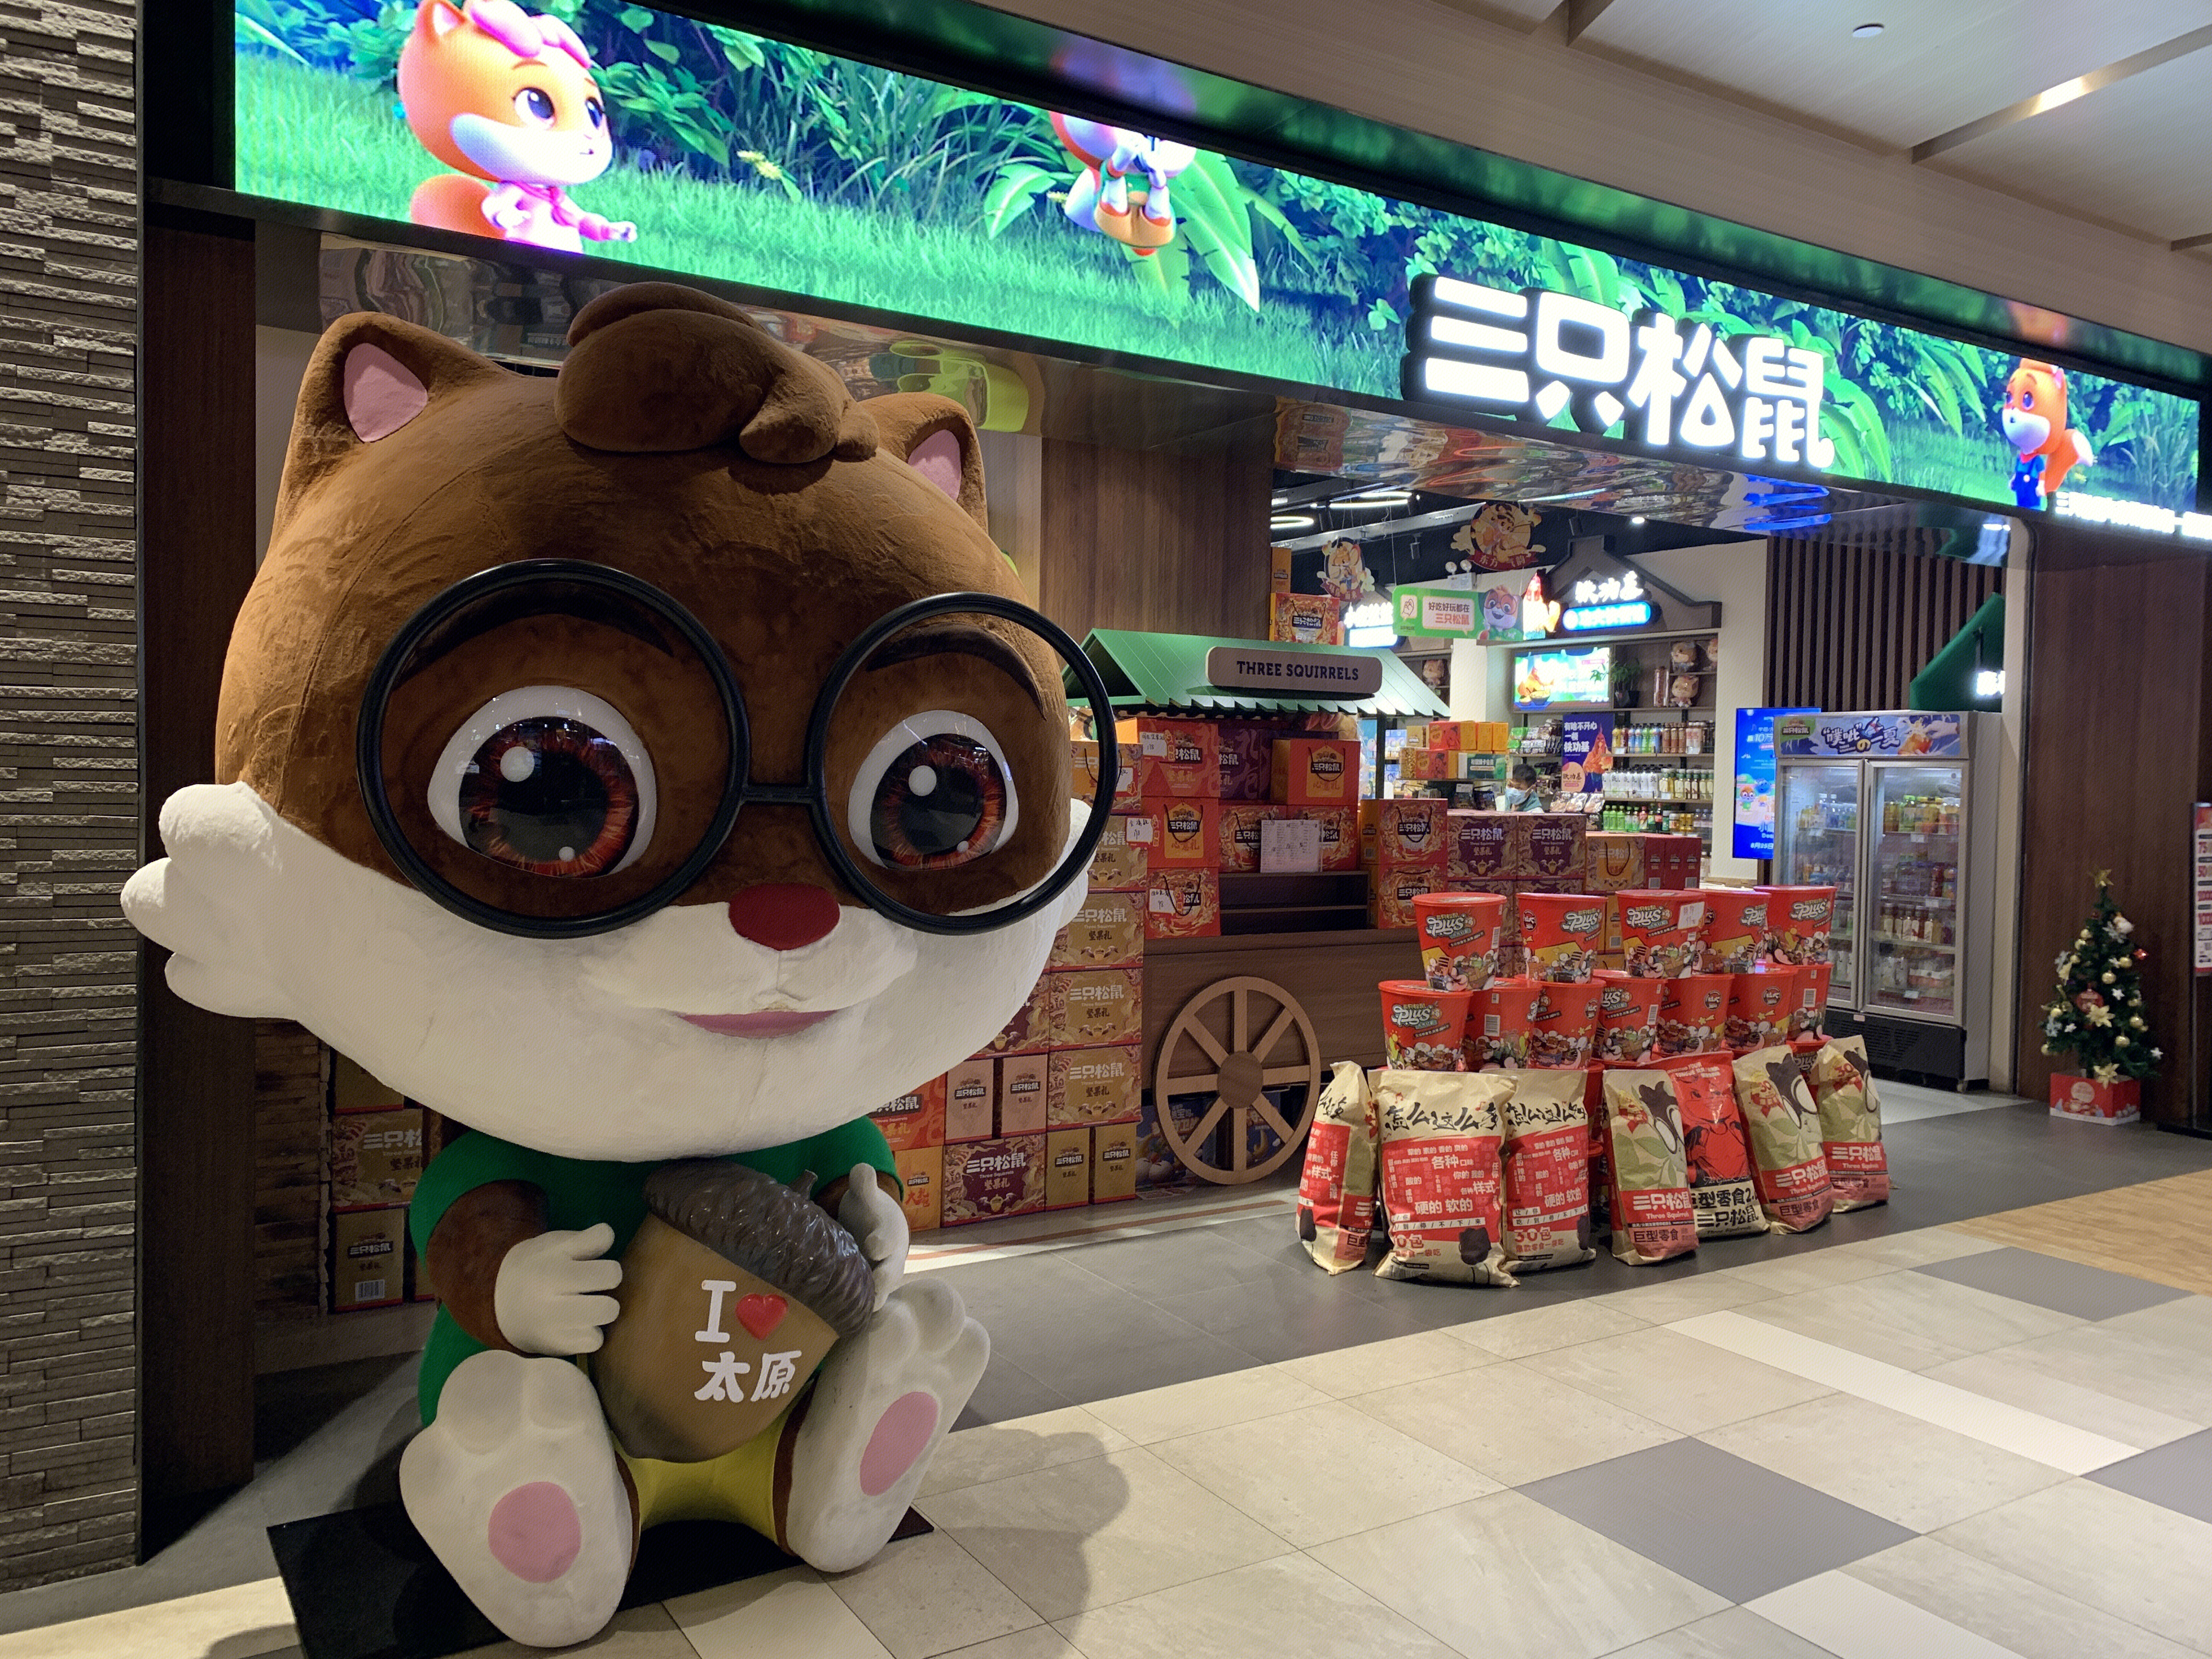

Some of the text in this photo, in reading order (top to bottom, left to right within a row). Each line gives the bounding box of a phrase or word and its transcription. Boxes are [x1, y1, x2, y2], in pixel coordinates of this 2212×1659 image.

[1426, 276, 1835, 468] 三只松鼠
[1429, 602, 1470, 612] 好吃好玩都在
[1435, 613, 1469, 625] 三只松鼠
[1237, 661, 1359, 680] THREE SQUIRRELS
[1564, 721, 1597, 731] 有啥不开心
[1312, 762, 1340, 772] 三只松鼠
[1170, 821, 1198, 831] 三只松鼠
[1399, 823, 1430, 833] 三只松鼠
[1460, 827, 1504, 841] 三只松鼠
[1532, 827, 1572, 841] 三只松鼠
[1474, 847, 1492, 855] 坚果礼
[1071, 909, 1127, 923] 三只松鼠
[1562, 912, 1599, 932] Plus
[1627, 909, 1661, 927] Plus
[1426, 917, 1464, 937] Plus
[1088, 930, 1113, 941] 坚果礼
[1069, 985, 1124, 1001] 三只松鼠
[1086, 1008, 1110, 1019] 坚果礼
[1391, 1006, 1431, 1026] Plus
[1069, 1063, 1124, 1080] 三只松鼠
[1835, 1063, 1854, 1077] 30
[956, 1087, 985, 1098] 三只松鼠
[1012, 1082, 1040, 1092] 三只松鼠
[1086, 1085, 1110, 1097] 坚果礼
[1056, 1155, 1084, 1165] 三只松鼠
[1104, 1149, 1130, 1159] 三只松鼠
[1831, 1146, 1883, 1162] 三只松鼠
[967, 1152, 1026, 1173] 三只松鼠
[1453, 1171, 1470, 1180] 你的
[1775, 1159, 1828, 1188] 三只松鼠
[984, 1178, 1010, 1190] 坚果礼
[1544, 1187, 1582, 1208] 硬的 软的
[1633, 1191, 1691, 1211] 三只松鼠
[1415, 1198, 1474, 1215] 硬的 软的
[1697, 1205, 1759, 1227] 三只松鼠
[1634, 1228, 1678, 1243] 巨型零食
[349, 1243, 391, 1256] 三只松鼠
[694, 1350, 802, 1403] 太原
